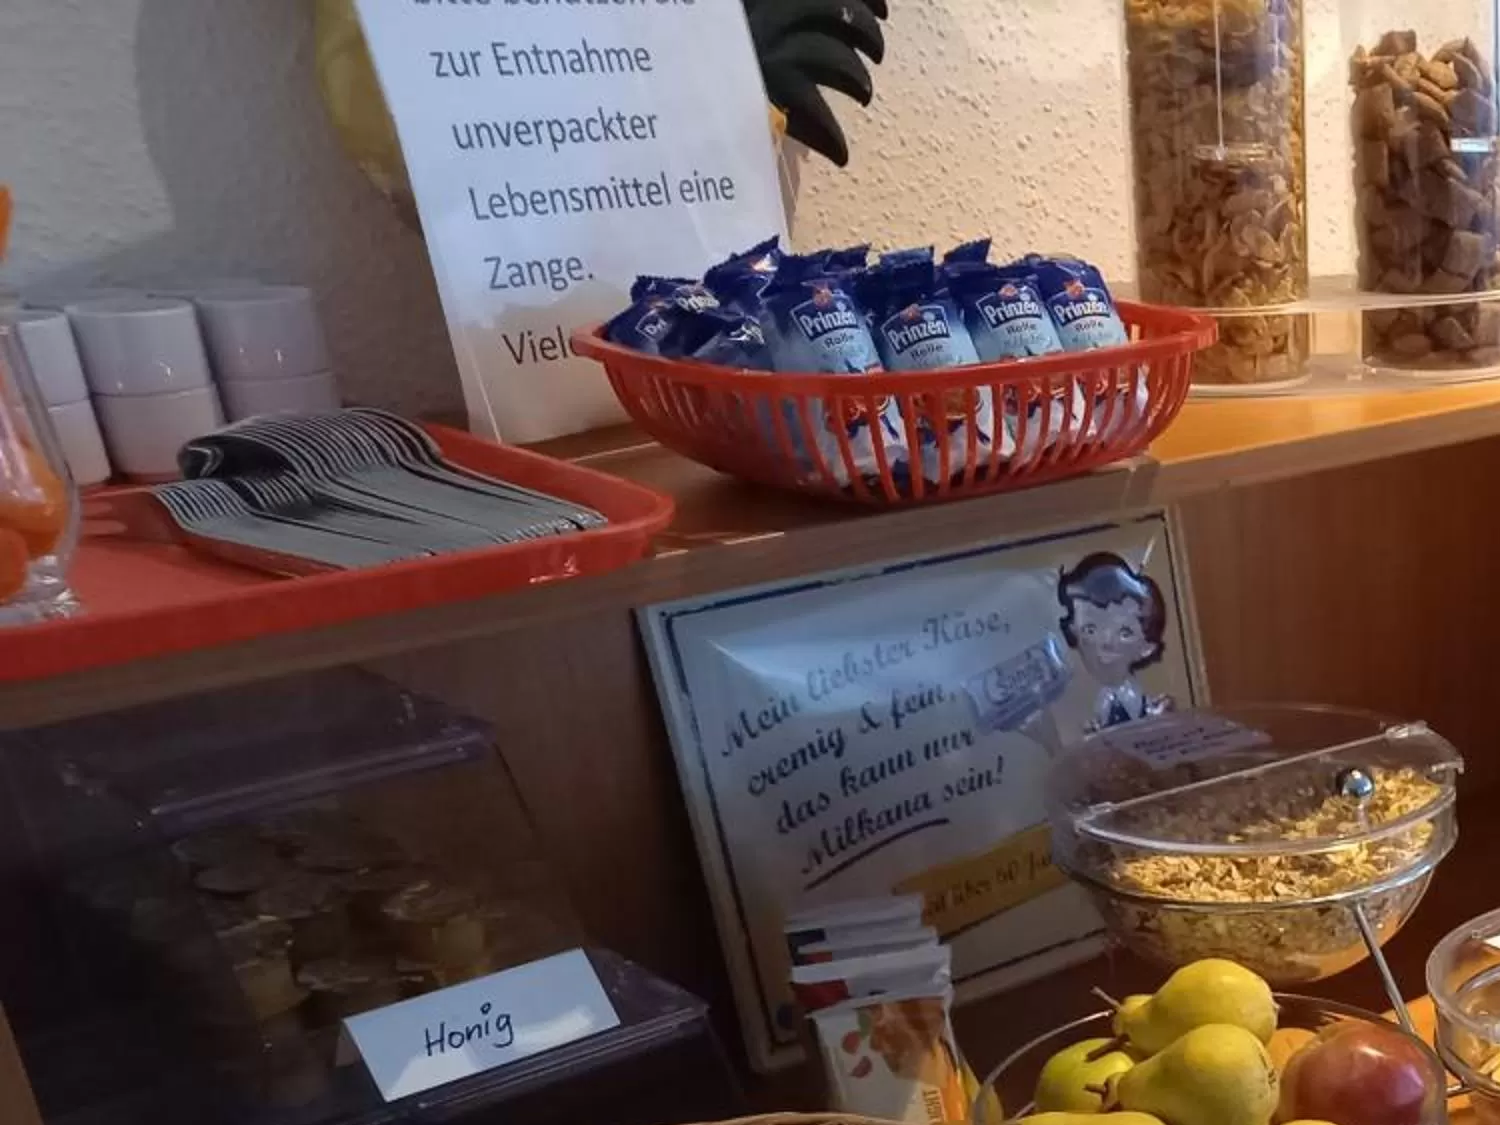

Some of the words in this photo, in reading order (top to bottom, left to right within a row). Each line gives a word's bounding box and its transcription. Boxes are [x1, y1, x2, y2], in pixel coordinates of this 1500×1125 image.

[429, 48, 482, 78] zur
[491, 37, 653, 76] Entnahme
[453, 107, 658, 152] unverpackter
[469, 171, 671, 220] Lebensmittel
[678, 170, 736, 204] eine
[484, 256, 594, 291] Zange.
[800, 308, 856, 337] Prinzen
[984, 298, 1042, 324] Prinzen
[1053, 299, 1110, 324] Prinzen
[502, 325, 575, 364] Viel
[888, 318, 949, 349] Prinzen
[721, 694, 801, 757] Mein
[806, 643, 913, 700] liebster
[748, 727, 846, 796] cremig
[776, 792, 831, 835] das
[840, 750, 917, 797] kann
[923, 729, 975, 761] nur
[801, 790, 933, 875] Milkana
[943, 755, 1004, 801] sein!
[425, 1002, 514, 1057] Honig
